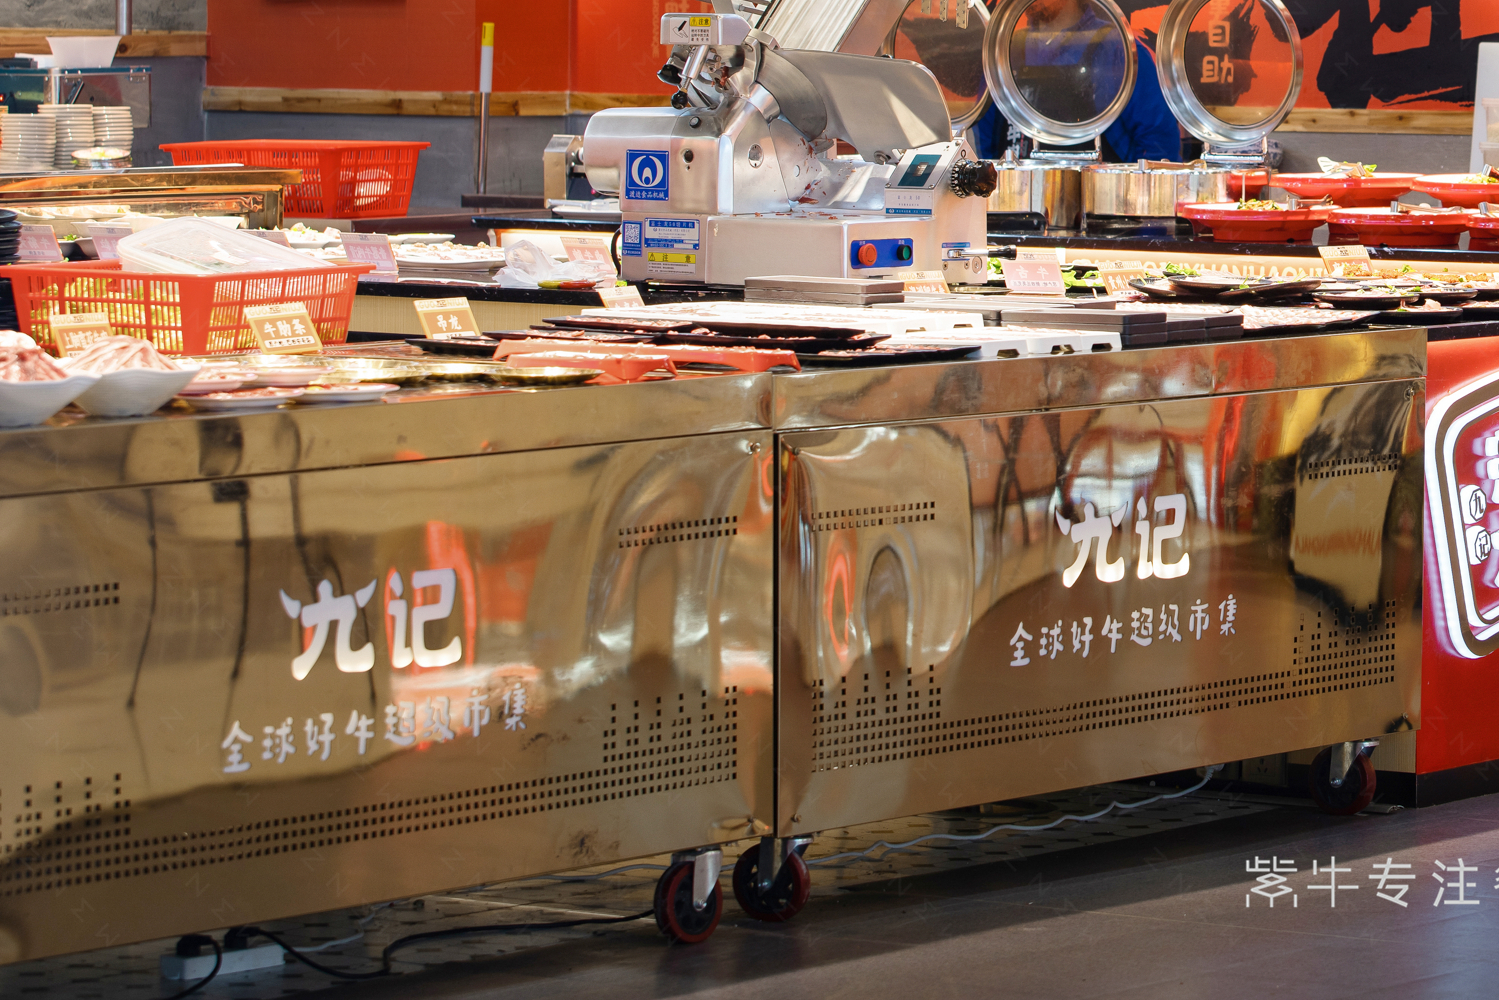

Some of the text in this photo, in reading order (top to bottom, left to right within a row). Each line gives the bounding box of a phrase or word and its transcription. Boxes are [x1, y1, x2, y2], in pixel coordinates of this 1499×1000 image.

[436, 314, 462, 331] 吊龙
[1055, 494, 1191, 588] 九记
[279, 566, 463, 681] 九记
[1008, 594, 1238, 667] 全球好牛超级市集
[222, 682, 529, 775] 全球好牛超级市集
